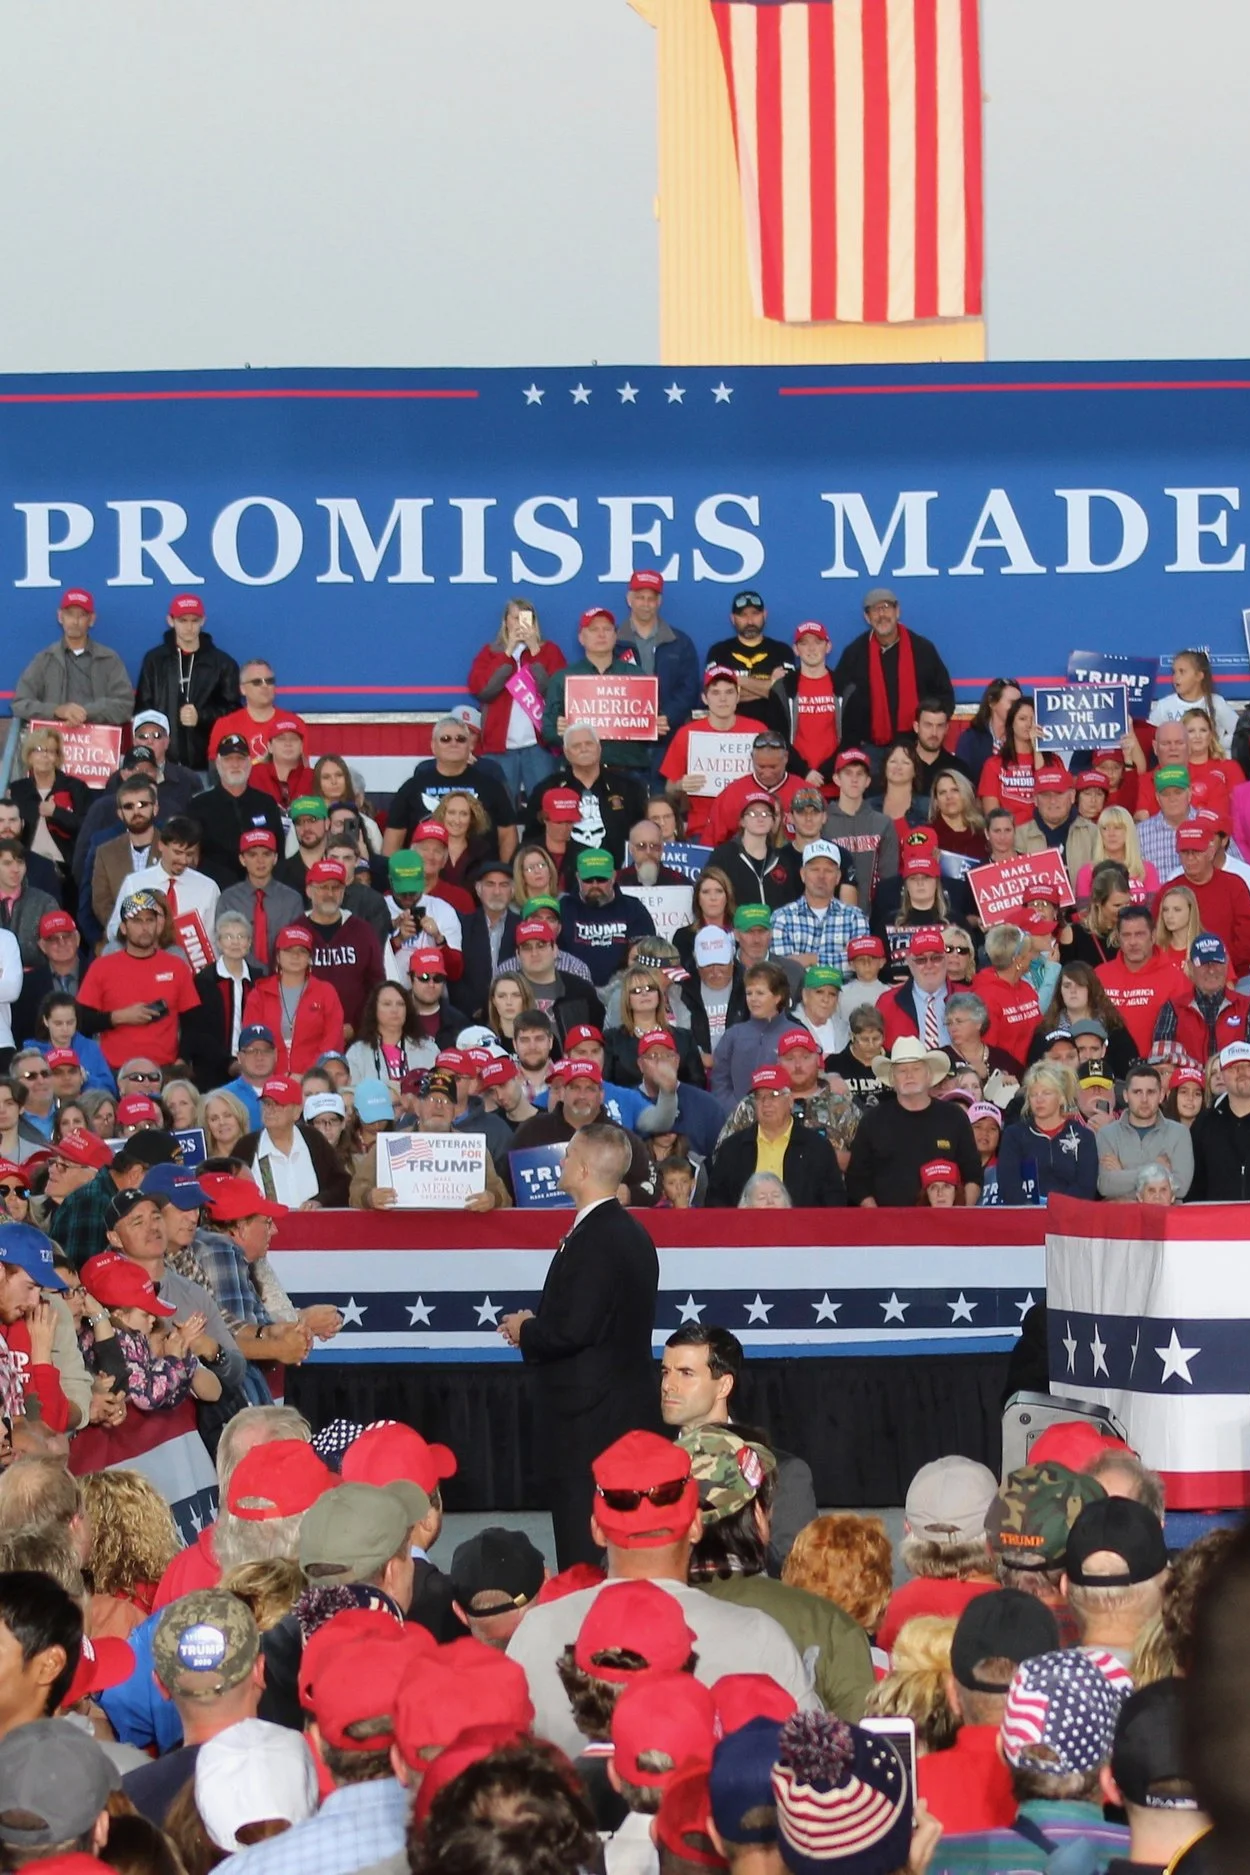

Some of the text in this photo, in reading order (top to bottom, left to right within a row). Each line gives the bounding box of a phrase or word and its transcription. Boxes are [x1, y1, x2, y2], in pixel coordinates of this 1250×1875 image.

[14, 487, 1247, 588] PROMISES MADE
[1075, 668, 1150, 688] TRUMP
[596, 686, 627, 696] MAKE
[568, 699, 656, 715] AMERICA
[1046, 692, 1114, 712] DRAIN
[614, 717, 649, 729] AGAIN
[1069, 710, 1094, 723] THE
[1042, 721, 1121, 743] SWAMP
[62, 734, 91, 744] MAKE
[720, 743, 751, 754] KEEP
[75, 764, 110, 777] AGAIN
[811, 842, 832, 854] USA
[1000, 864, 1032, 879] MAKE
[979, 870, 1067, 903] AMERICA
[576, 922, 627, 938] TRUMP
[1196, 938, 1220, 948] TRUMP
[428, 1139, 482, 1150] VETERANS
[460, 1150, 482, 1159] FOR
[406, 1160, 483, 1173] TRUMP
[412, 1182, 474, 1195] AMERICA
[1000, 1532, 1044, 1548] TRUMP
[180, 1643, 225, 1657] TRUMP
